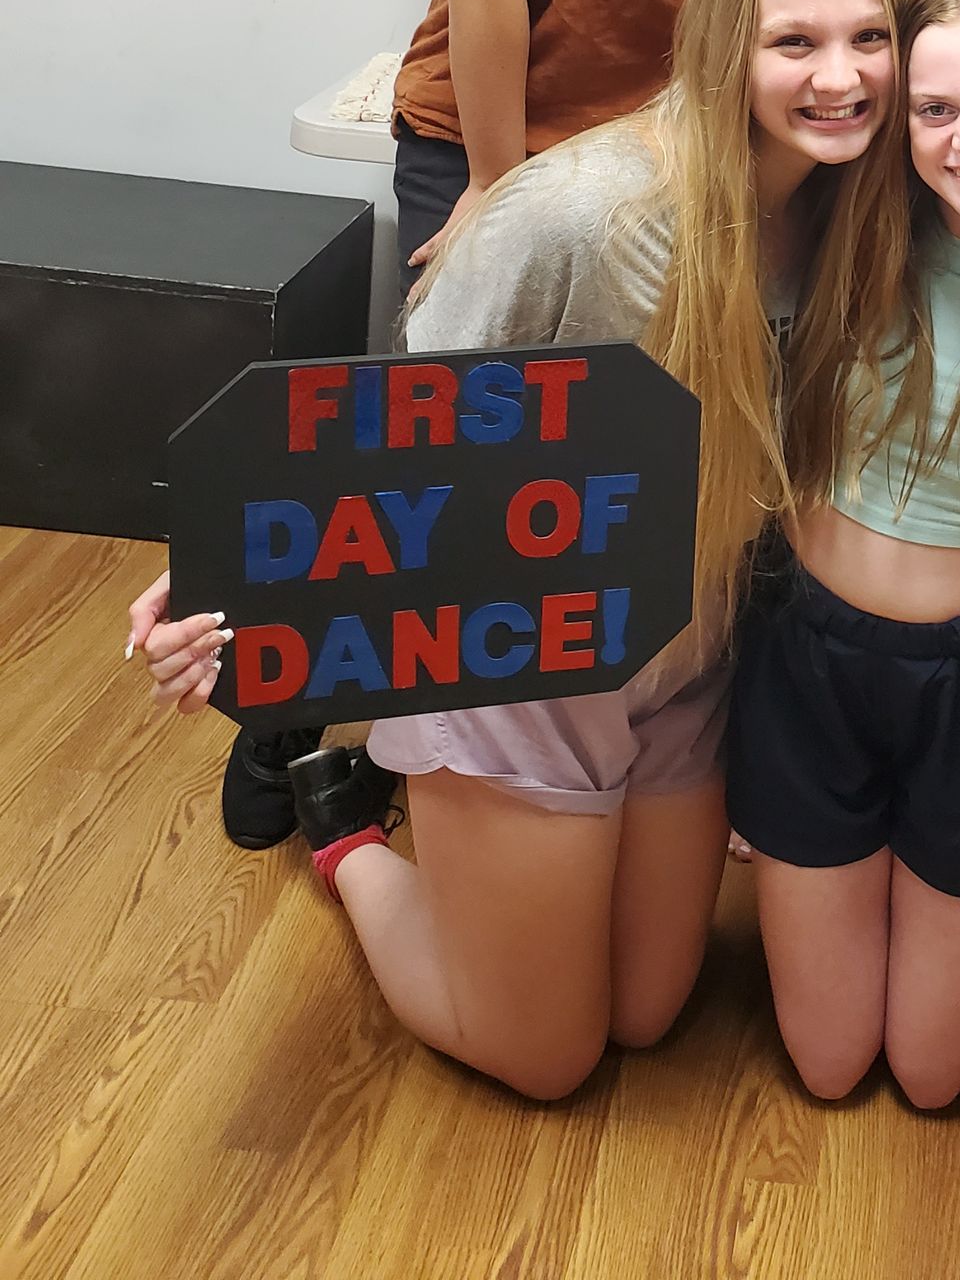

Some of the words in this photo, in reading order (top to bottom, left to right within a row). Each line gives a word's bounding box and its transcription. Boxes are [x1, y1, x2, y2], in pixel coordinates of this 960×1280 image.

[288, 358, 589, 453] FIRST
[243, 485, 454, 584] DAY
[505, 473, 639, 558] OF
[234, 587, 631, 708] DANCE!
